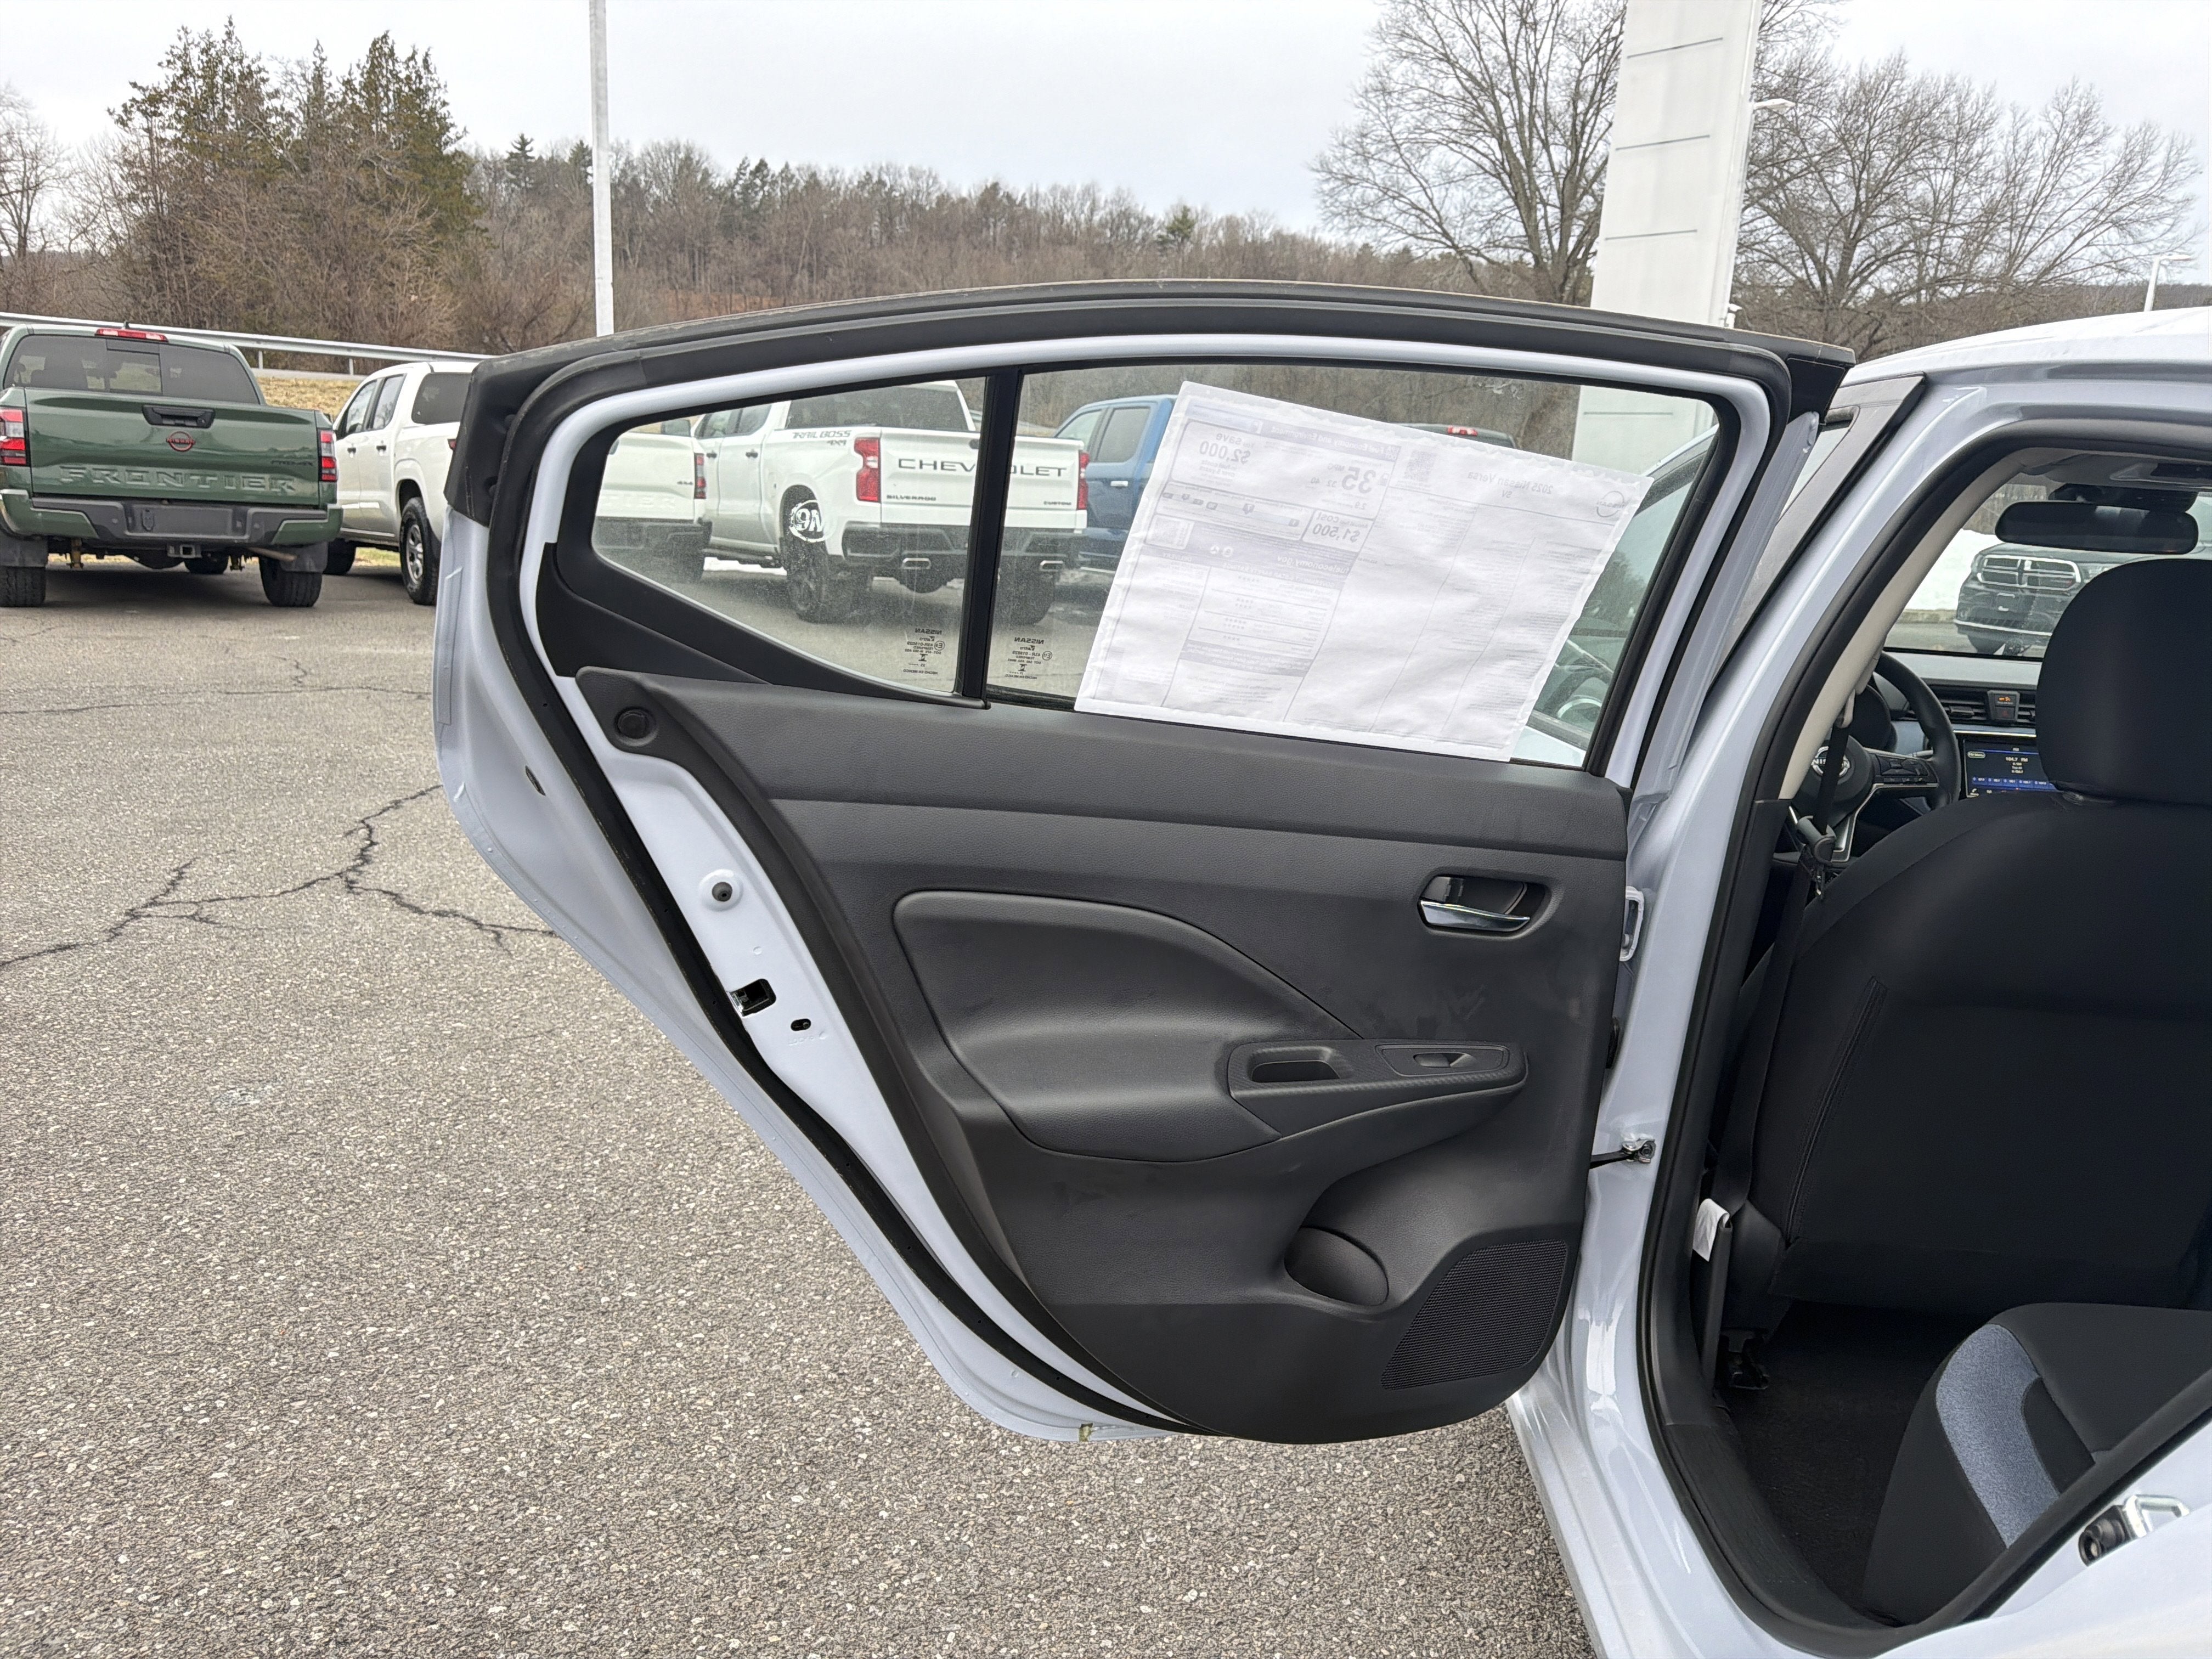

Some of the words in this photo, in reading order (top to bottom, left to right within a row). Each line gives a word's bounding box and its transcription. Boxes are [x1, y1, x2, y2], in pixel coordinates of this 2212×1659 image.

[819, 430, 852, 438] BOSS
[898, 458, 1067, 477] CHEVLET
[59, 464, 296, 492] FRONTIER
